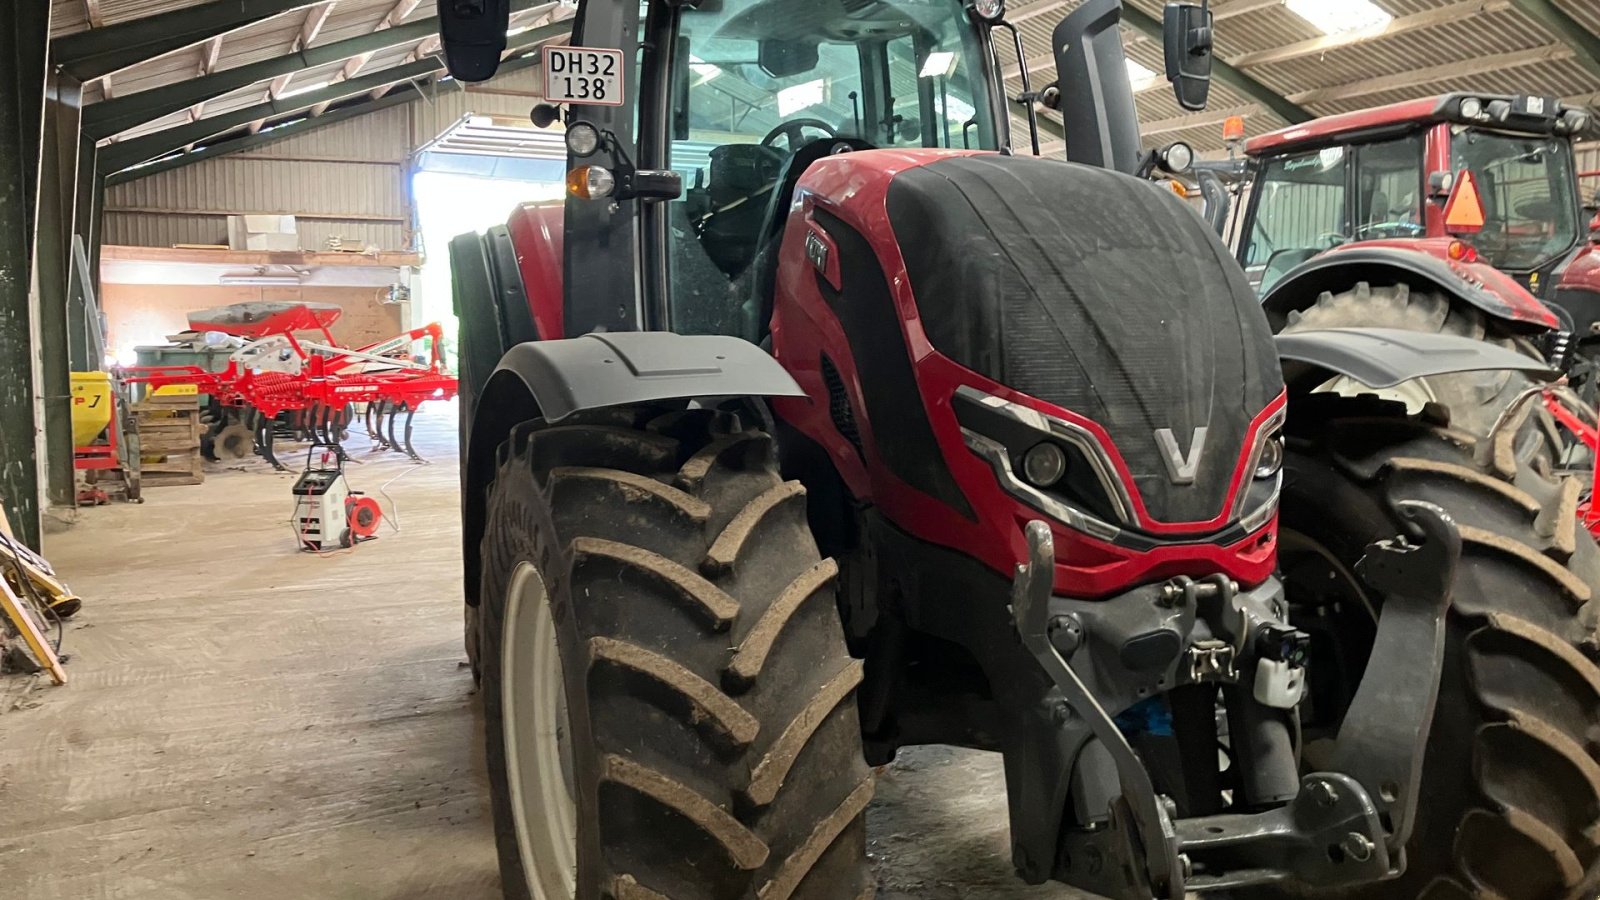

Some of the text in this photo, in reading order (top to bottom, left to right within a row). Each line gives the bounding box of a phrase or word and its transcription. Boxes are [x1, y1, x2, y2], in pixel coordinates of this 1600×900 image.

[551, 52, 614, 76] DH32
[564, 77, 605, 100] 138
[1153, 427, 1208, 483] V
